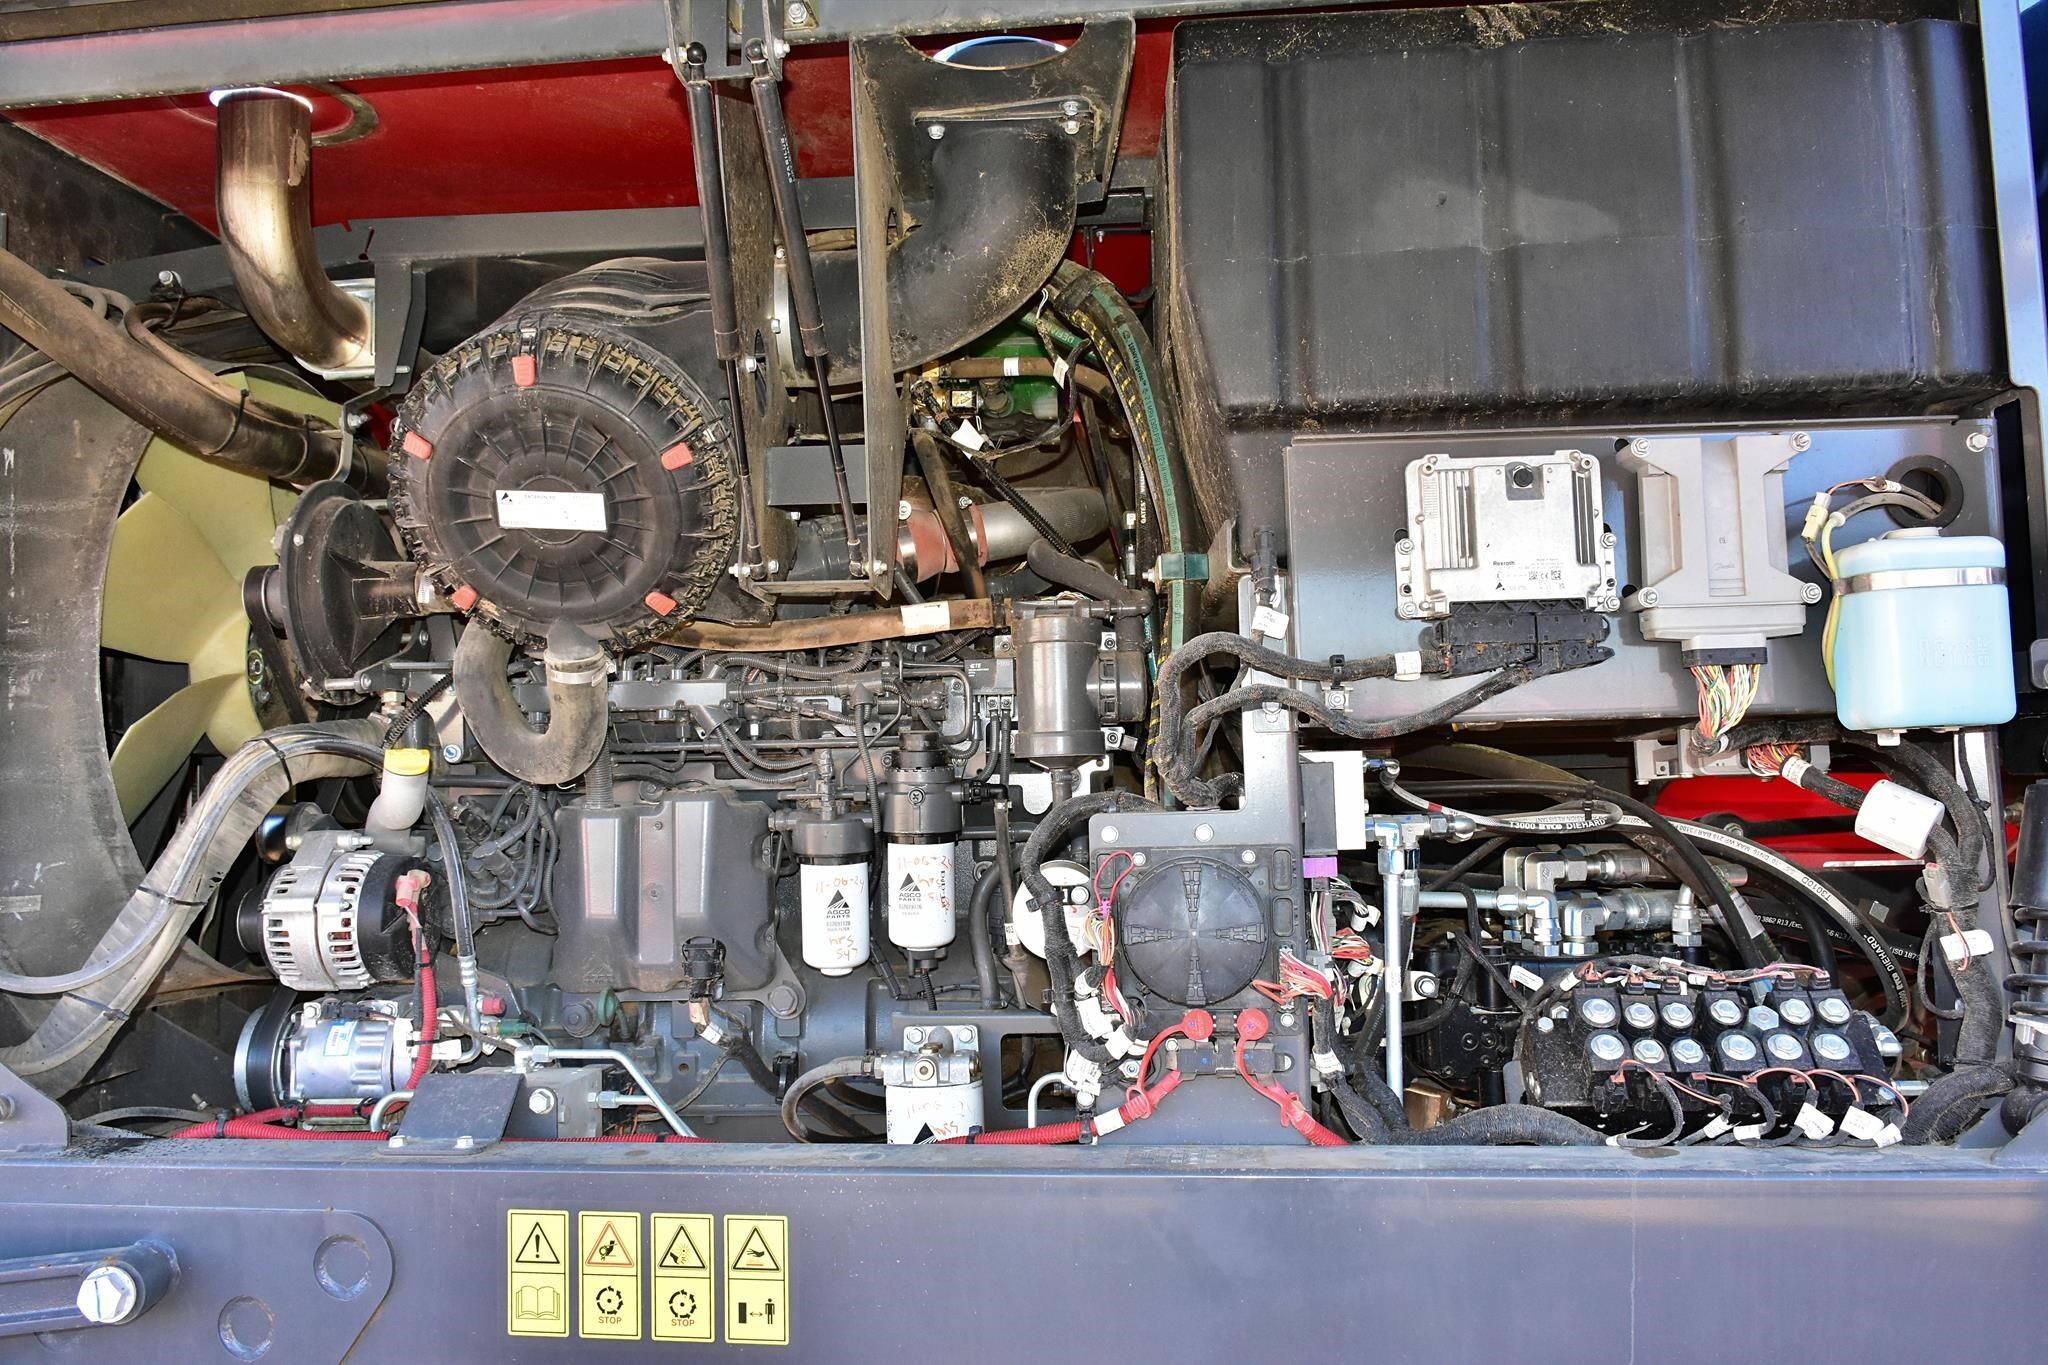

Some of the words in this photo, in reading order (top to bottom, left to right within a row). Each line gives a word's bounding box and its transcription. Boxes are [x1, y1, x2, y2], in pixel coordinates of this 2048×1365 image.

[780, 138, 793, 183] STABILUS
[1566, 818, 1606, 830] DIEHARD
[1800, 874, 1832, 901] T3010D
[1865, 936, 1895, 972] DIEHARD
[598, 1316, 622, 1325] STOP
[670, 1318, 695, 1327] STOP
